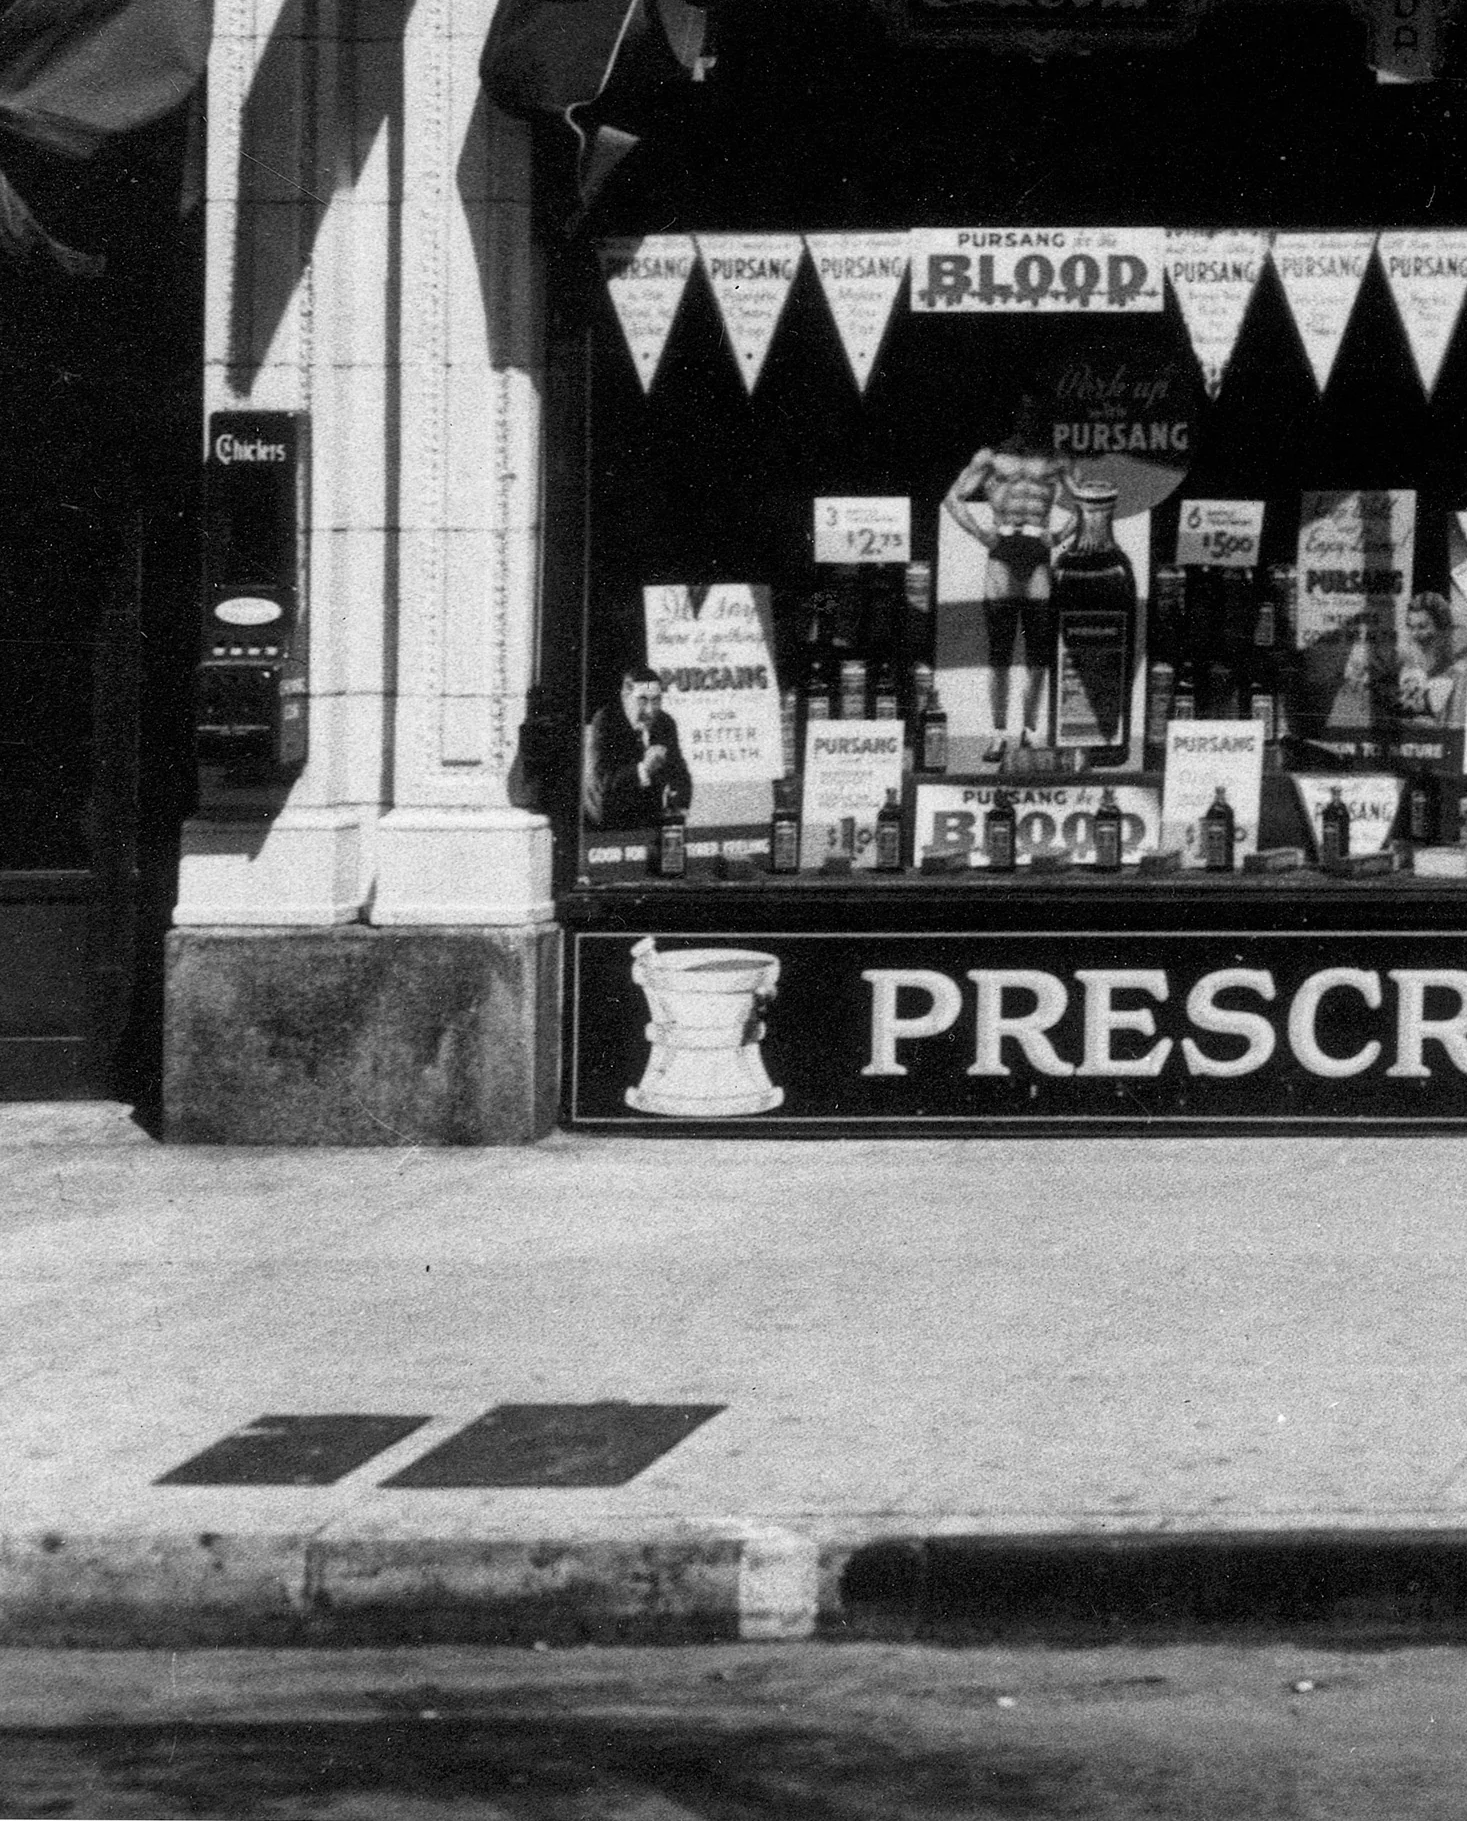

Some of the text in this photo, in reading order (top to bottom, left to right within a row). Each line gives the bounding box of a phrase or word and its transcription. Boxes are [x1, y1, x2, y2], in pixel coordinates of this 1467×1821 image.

[958, 232, 1066, 249] PURSANG
[710, 257, 794, 280] PURSANG
[819, 257, 902, 280] PURSANG
[1173, 260, 1252, 283] PURSANG
[1281, 255, 1363, 279] PURSANG
[922, 254, 1155, 307] BLOOD
[1053, 421, 1189, 451] PURSANG
[825, 506, 839, 528] 3
[1187, 506, 1203, 530] 6
[659, 664, 769, 692] PURSANG
[813, 736, 898, 756] PURSANG
[1172, 735, 1256, 754] PURSANG
[962, 789, 1068, 806] PUSANG
[1314, 800, 1394, 822] PSANG
[930, 810, 1146, 857] BOOD
